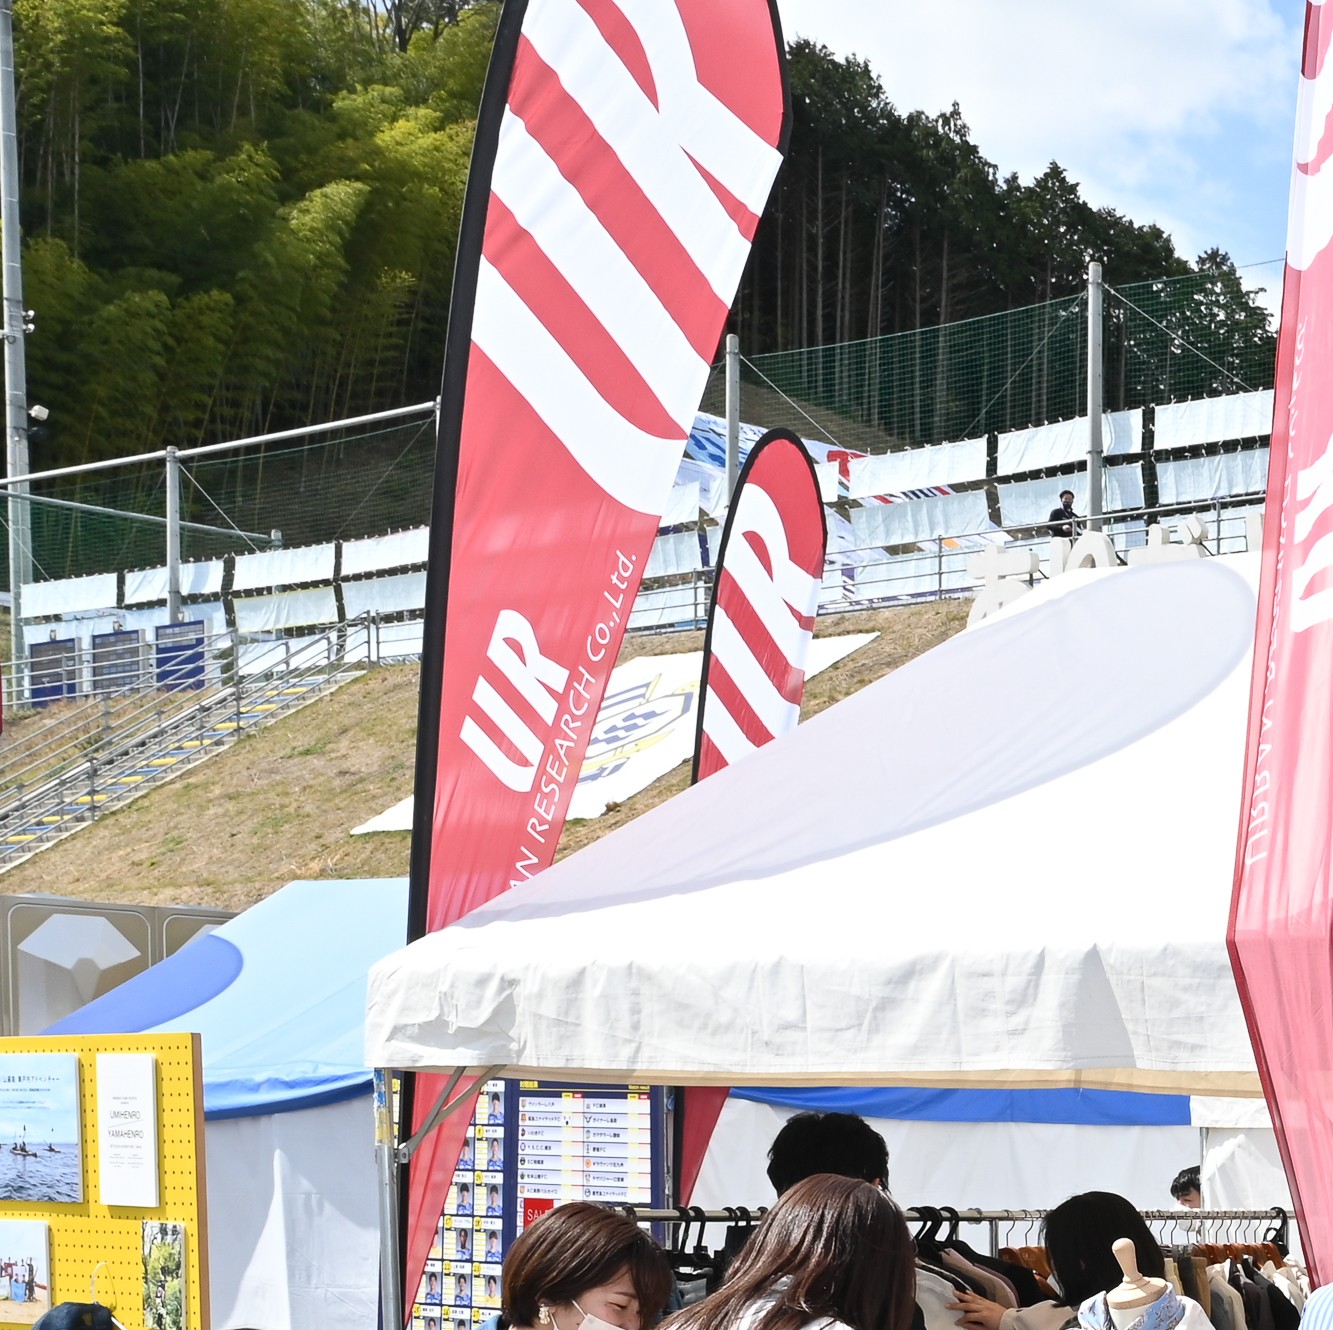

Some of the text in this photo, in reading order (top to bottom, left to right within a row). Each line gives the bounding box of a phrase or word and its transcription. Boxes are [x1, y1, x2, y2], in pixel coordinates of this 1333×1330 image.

[459, 608, 571, 793] UR
[527, 549, 637, 844] RESEARCH Co.,Ltd.
